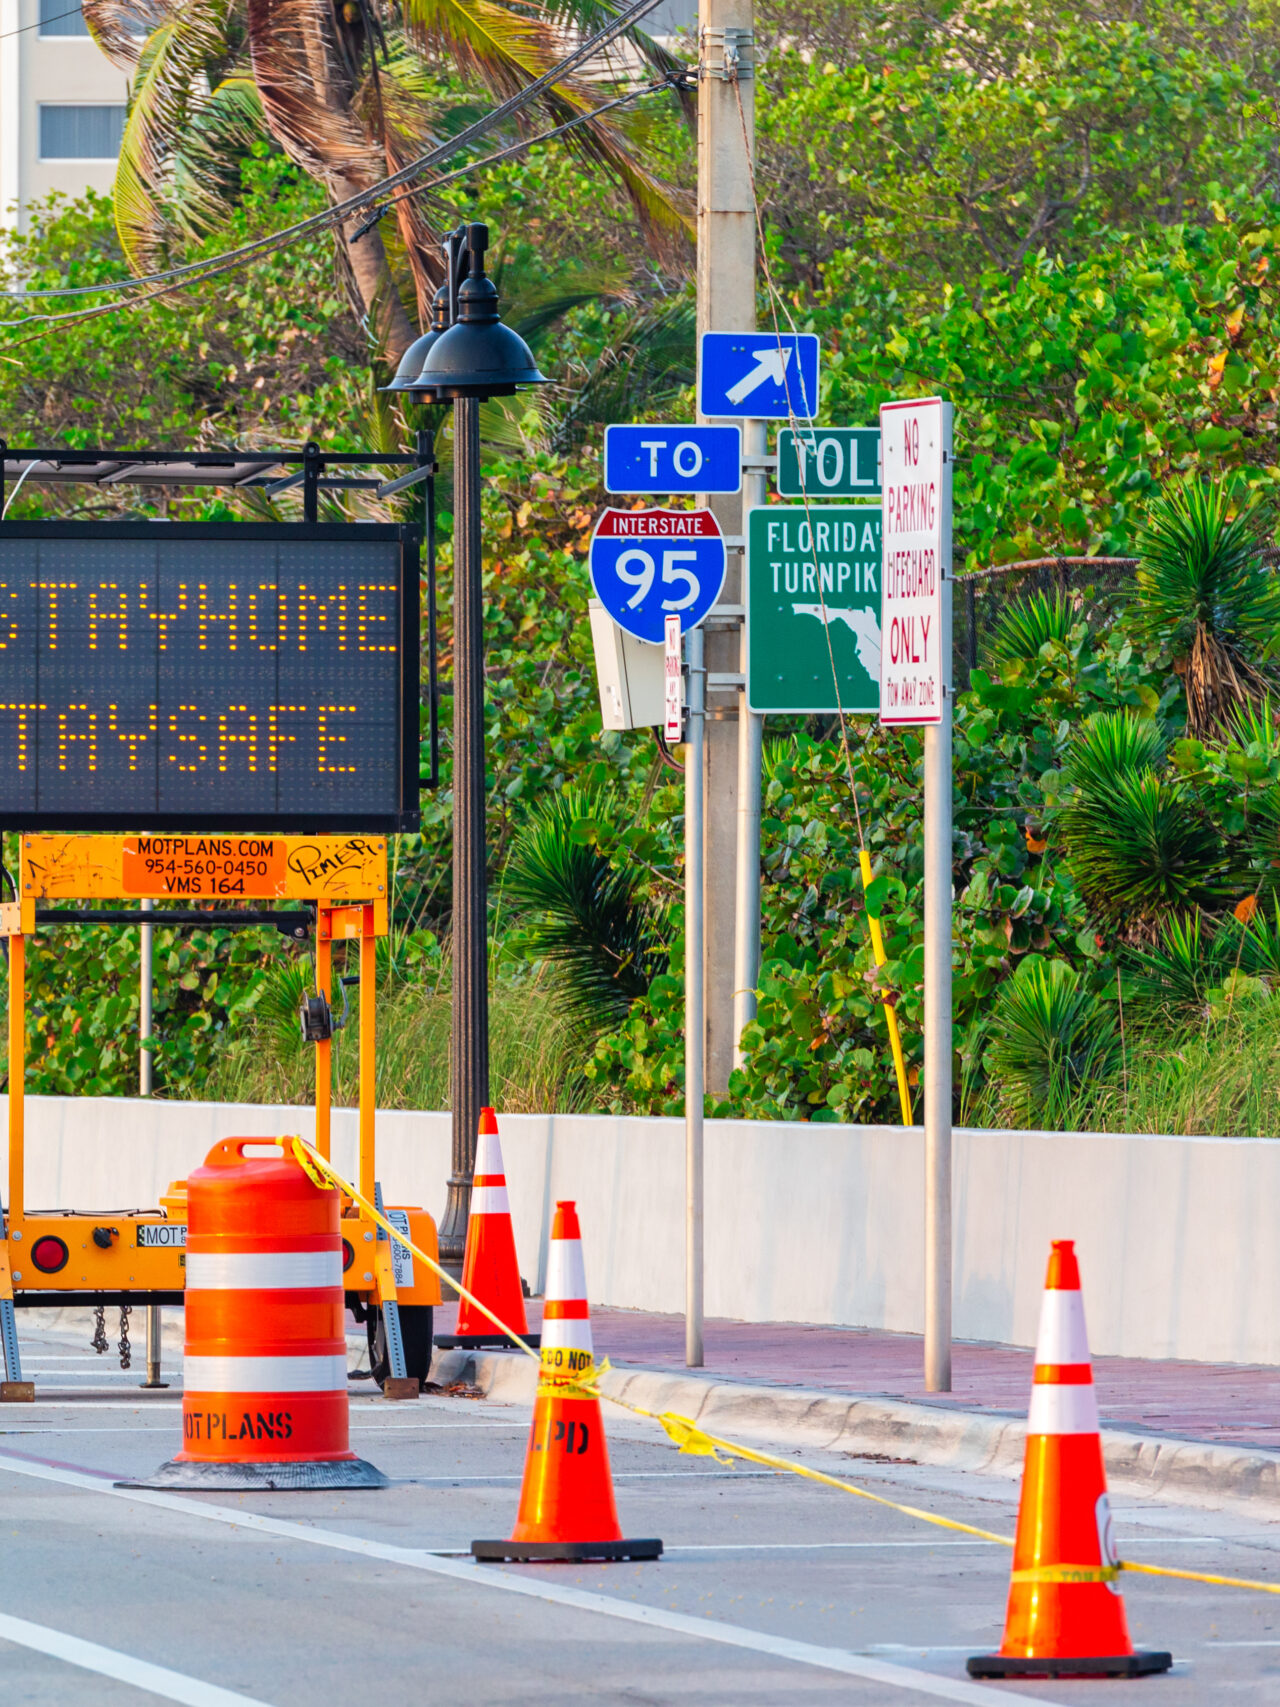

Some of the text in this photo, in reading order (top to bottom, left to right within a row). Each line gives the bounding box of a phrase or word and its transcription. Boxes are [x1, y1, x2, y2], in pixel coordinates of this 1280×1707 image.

[904, 417, 919, 467] NO
[641, 441, 703, 478] TO
[790, 438, 882, 487] TOL
[888, 482, 935, 534] PARKING
[613, 517, 703, 535] INTERSTATE
[768, 522, 882, 553] FLORIDA'
[615, 549, 700, 611] 95
[770, 562, 882, 593] TURNPIK
[887, 549, 935, 599] LIFEGUARD
[889, 615, 931, 665] ONLY
[138, 839, 274, 857] MOTPLANS.COM
[145, 860, 267, 876] 954-560-0450
[165, 877, 245, 894] VMS 164
[146, 1227, 178, 1245] MOT
[547, 1350, 563, 1367] DO
[568, 1351, 591, 1371] NOT
[184, 1412, 293, 1440] OT PLANS
